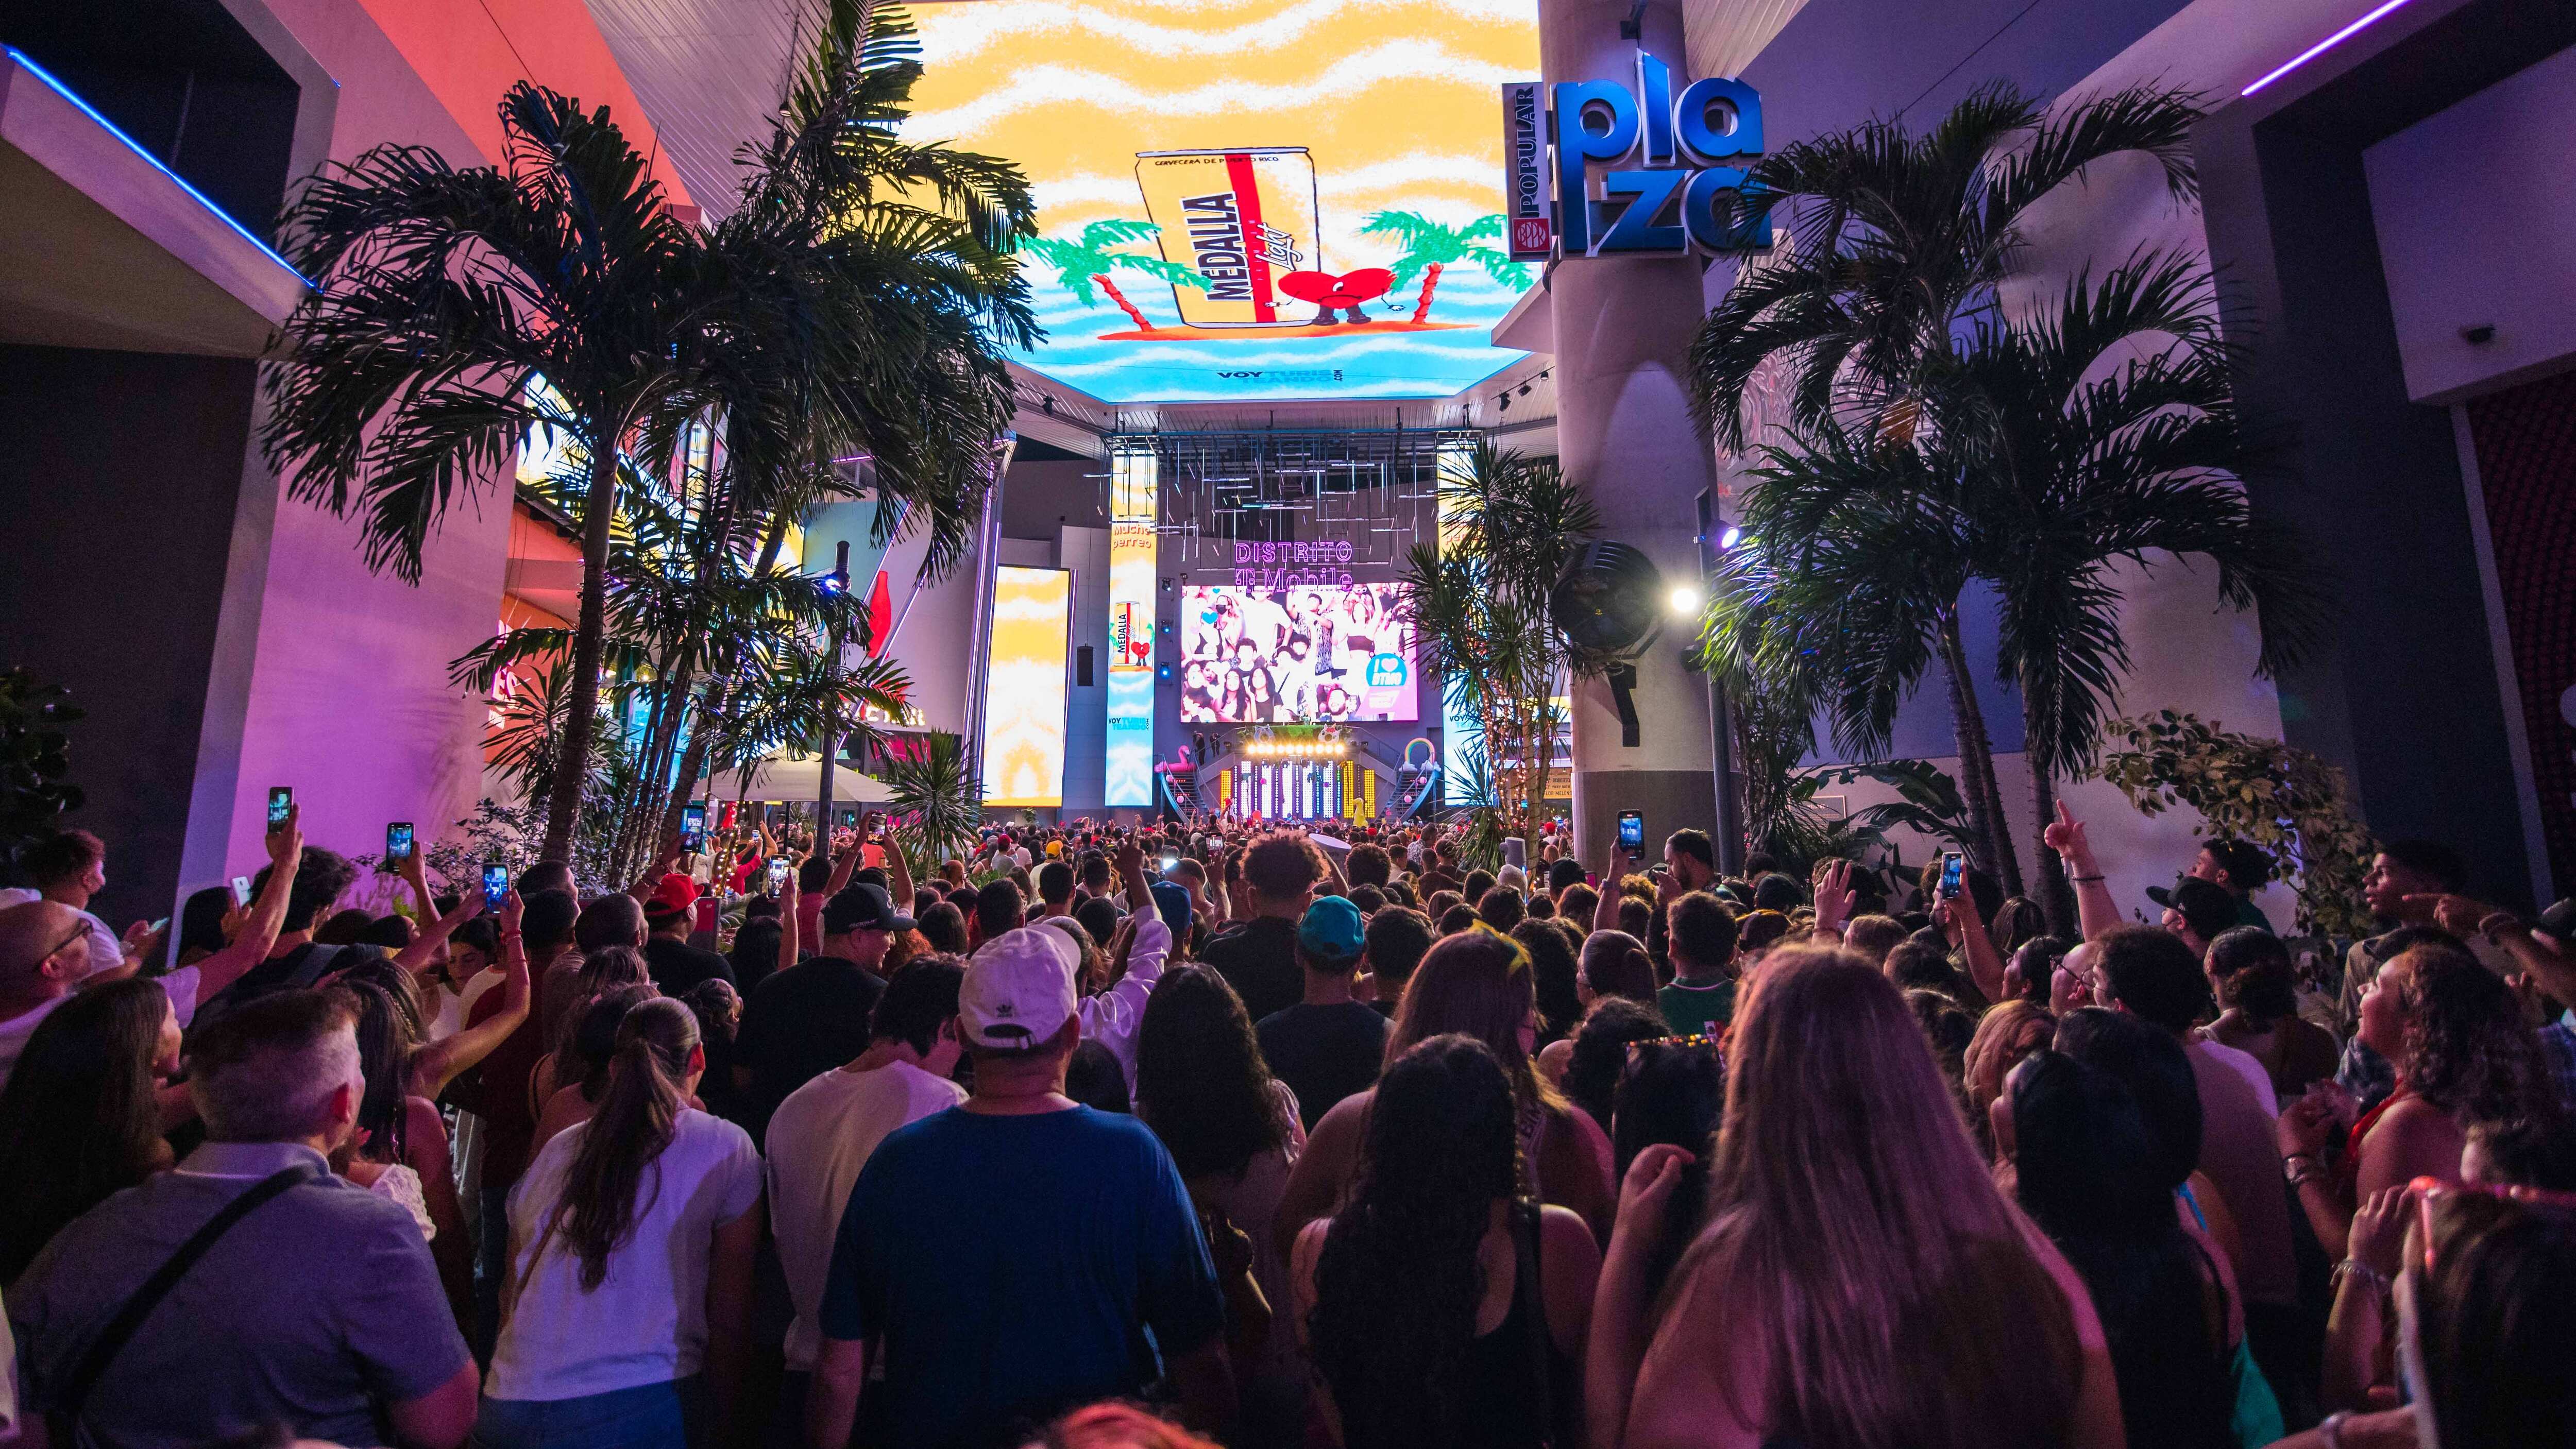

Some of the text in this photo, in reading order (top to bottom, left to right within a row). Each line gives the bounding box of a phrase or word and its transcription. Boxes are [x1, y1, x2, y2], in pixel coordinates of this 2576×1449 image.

[1516, 84, 1540, 218] POPULAR
[1180, 191, 1255, 302] MEDALLA
[1255, 222, 1303, 271] Light
[1113, 537, 1152, 552] perreo
[1235, 540, 1353, 563] DISTRITO
[1117, 613, 1127, 653] MEDALLA
